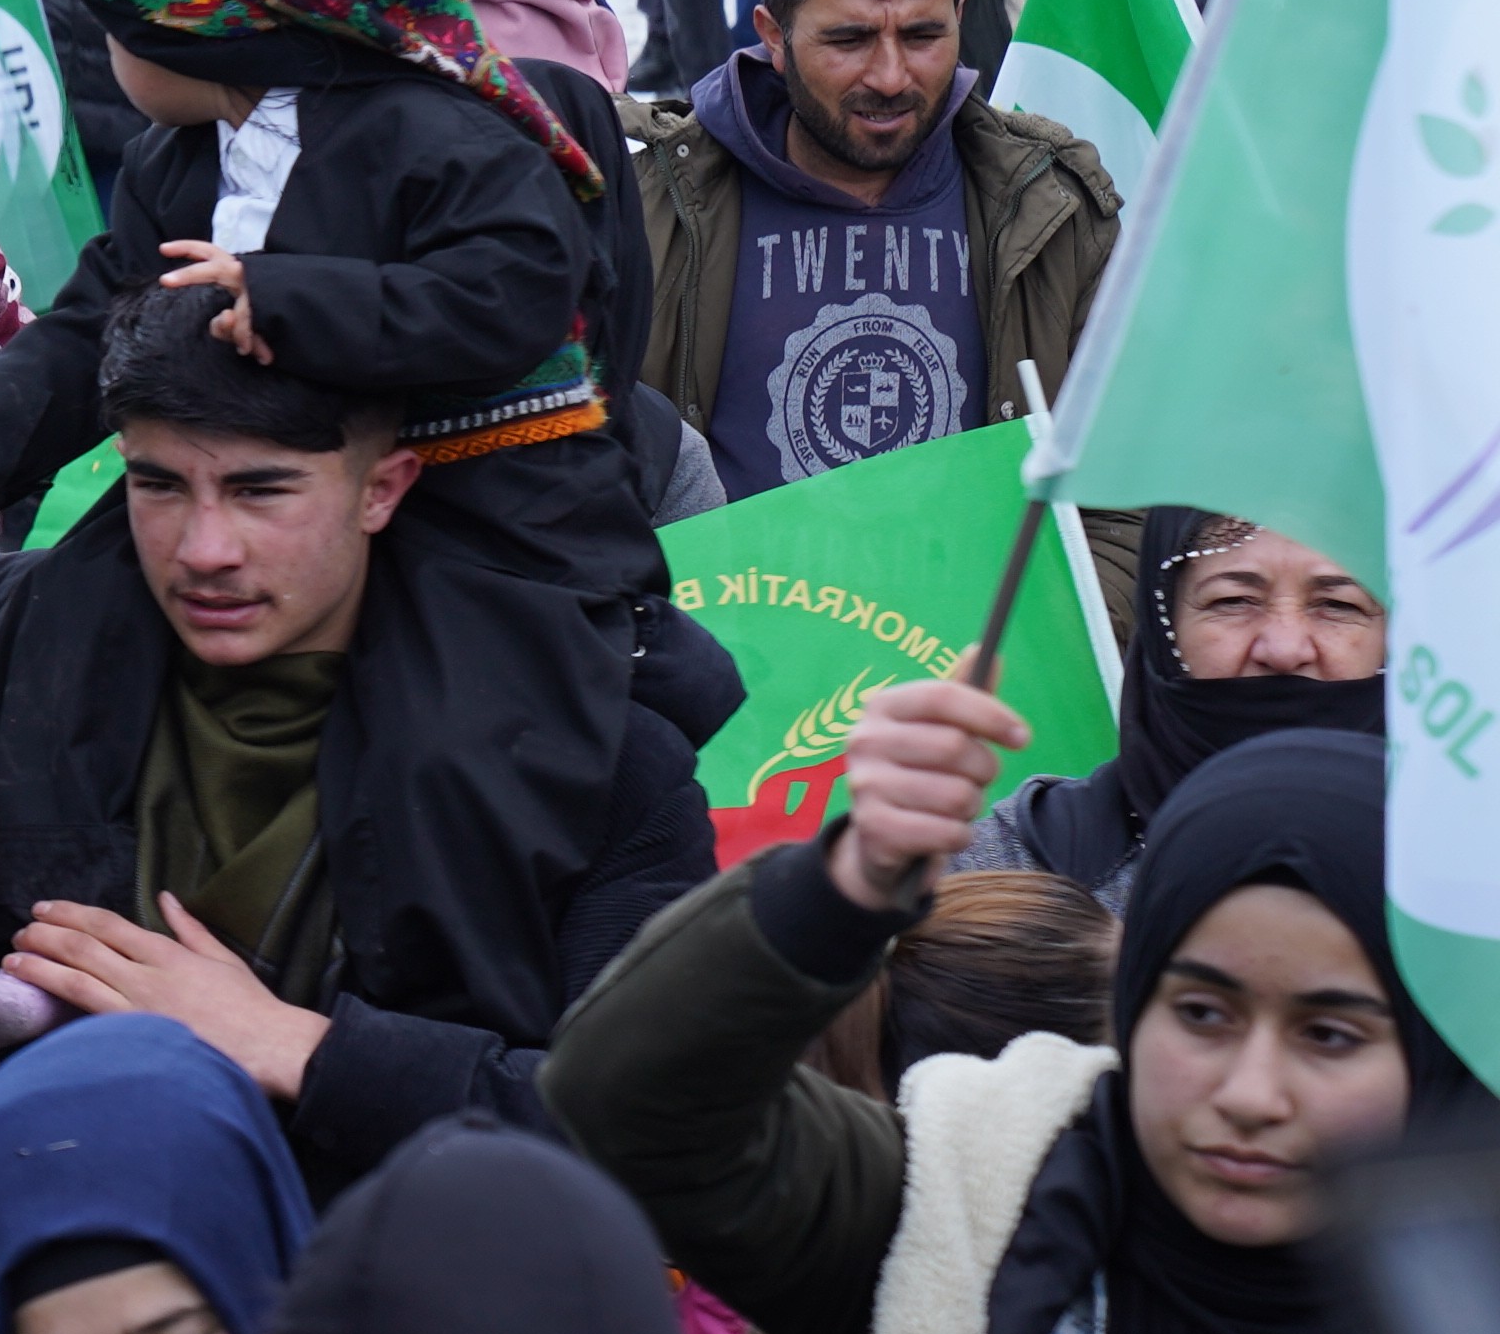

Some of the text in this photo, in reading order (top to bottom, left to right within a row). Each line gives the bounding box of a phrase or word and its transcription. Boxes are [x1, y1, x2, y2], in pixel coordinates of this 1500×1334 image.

[757, 223, 971, 300] TWENTY
[795, 317, 941, 380] RUN FROM FEAR
[790, 427, 816, 467] REAR
[1399, 642, 1496, 780] SOL
